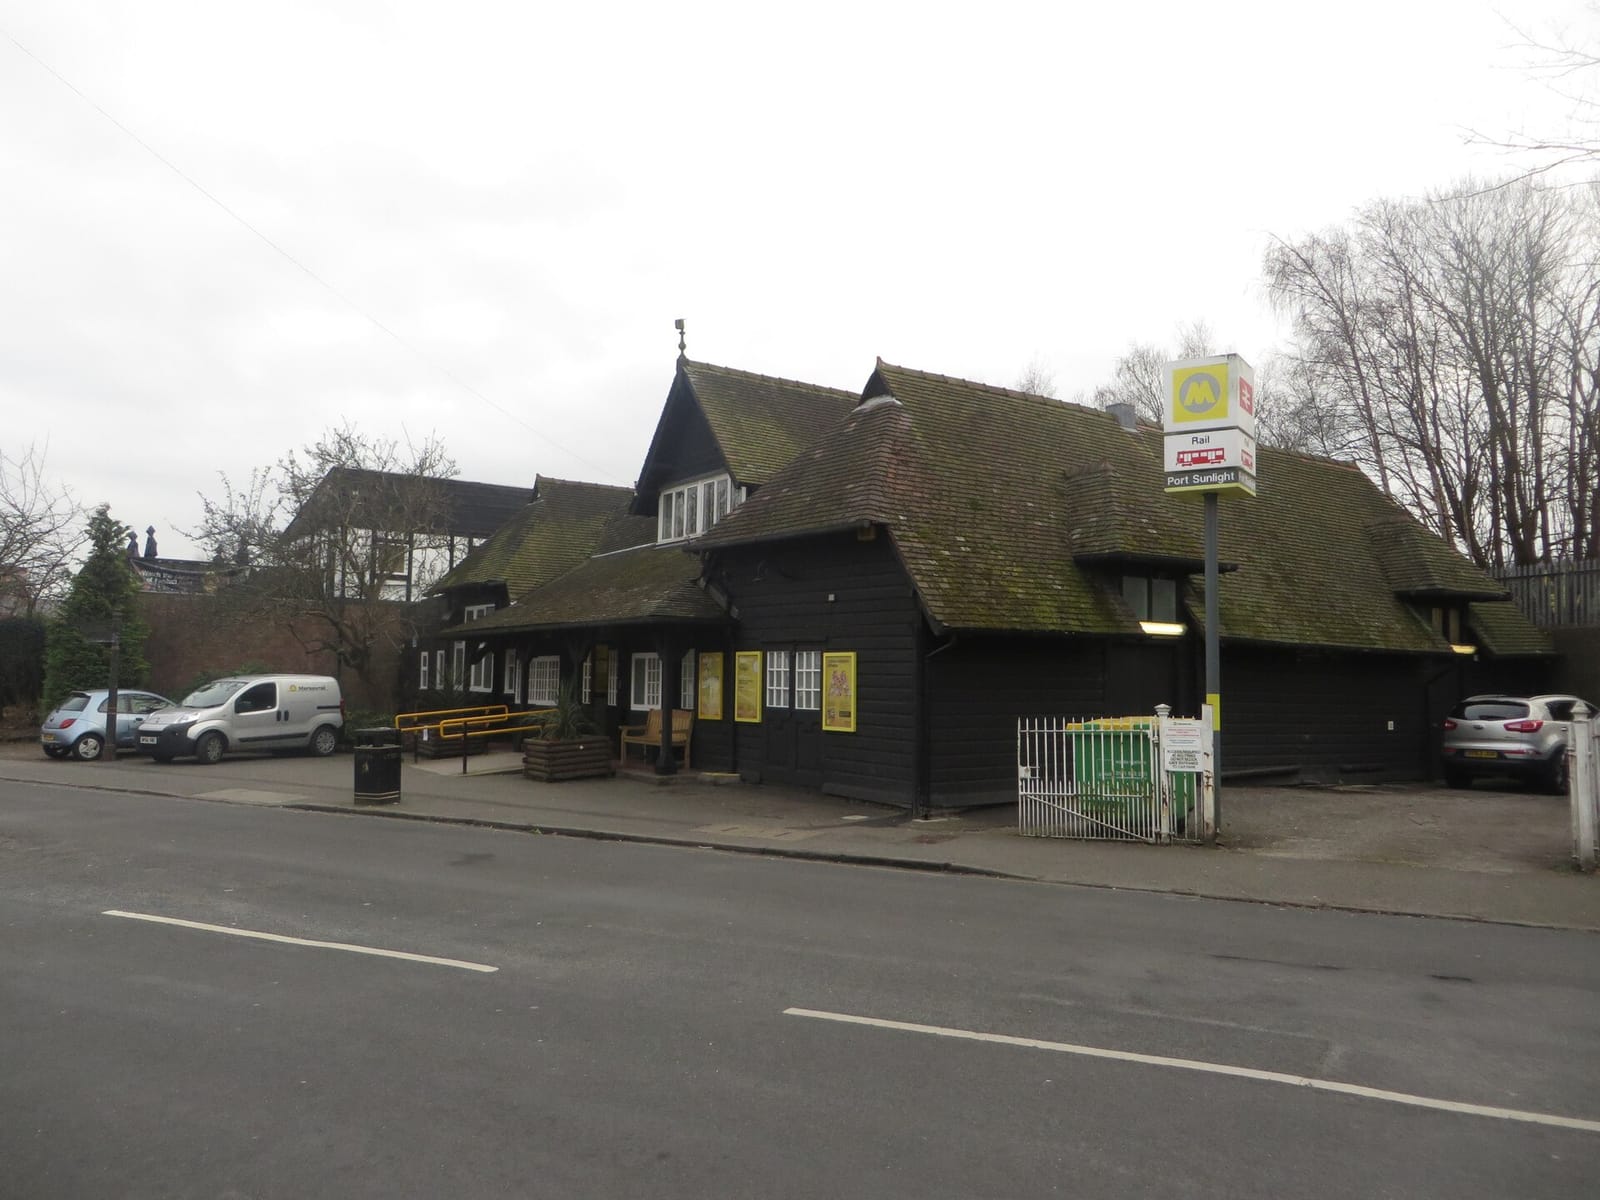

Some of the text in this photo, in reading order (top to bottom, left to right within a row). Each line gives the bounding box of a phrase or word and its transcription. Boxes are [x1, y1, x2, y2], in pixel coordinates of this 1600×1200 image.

[1191, 435, 1210, 445] Rail
[1167, 476, 1189, 486] Port
[1192, 472, 1235, 484] Sunlight
